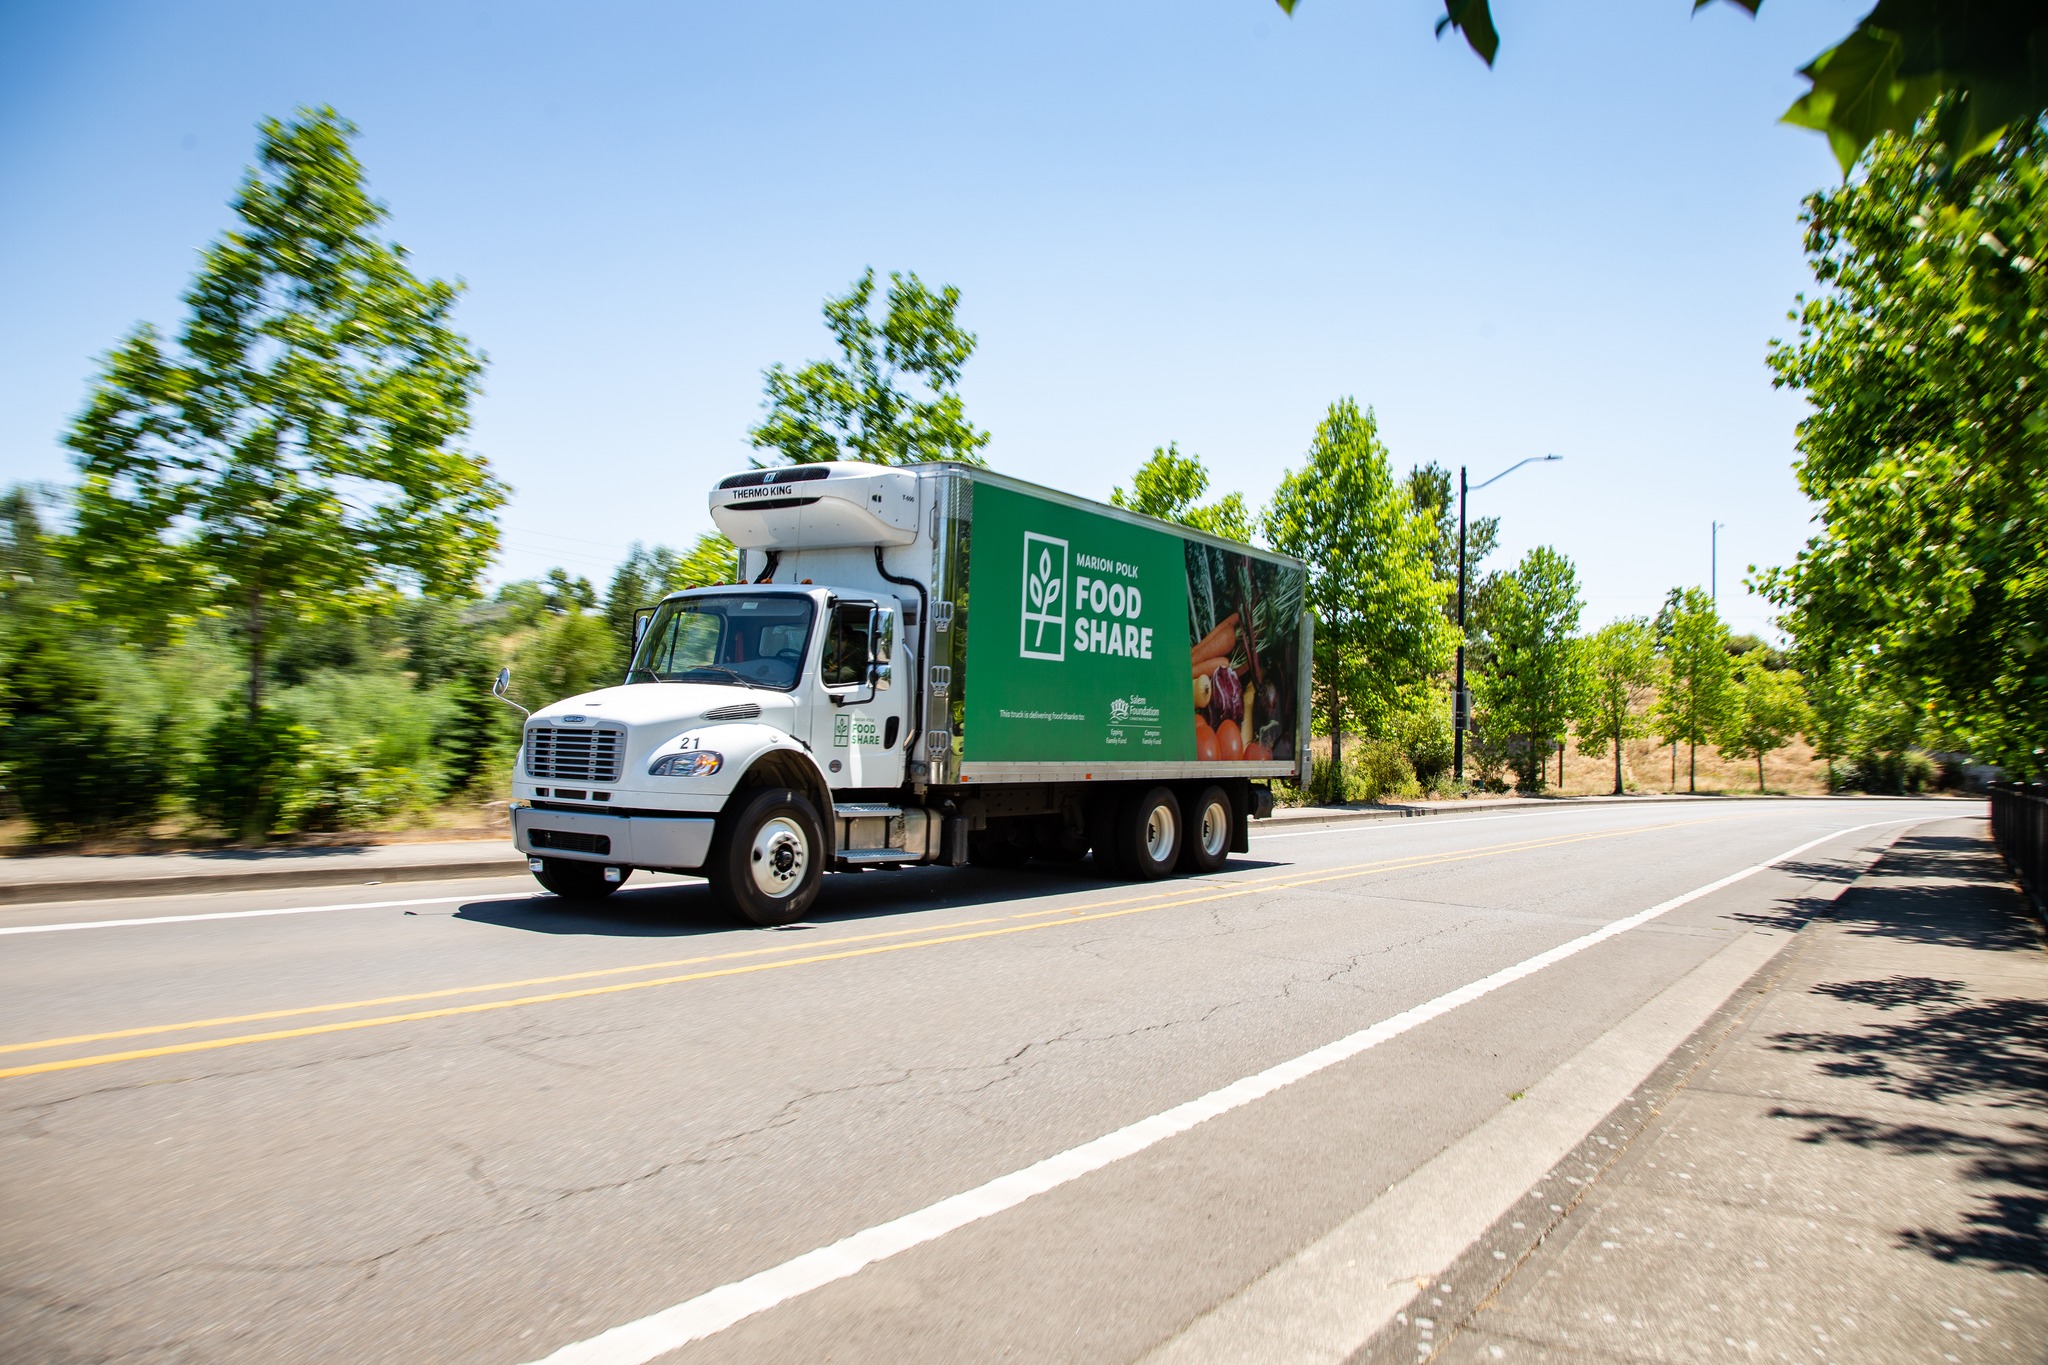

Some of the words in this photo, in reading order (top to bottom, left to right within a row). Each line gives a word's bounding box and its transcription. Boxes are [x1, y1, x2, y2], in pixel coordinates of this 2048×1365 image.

[732, 487, 769, 499] THERMO
[770, 485, 792, 497] KING
[1076, 553, 1113, 573] MARION
[1116, 561, 1138, 579] POLK
[1076, 576, 1142, 619] FOOD
[1073, 617, 1153, 660] SHARE
[1130, 694, 1146, 705] Salem
[999, 709, 1010, 718] This
[1130, 705, 1160, 716] Foundation
[852, 724, 876, 734] FOOD
[680, 737, 700, 750] 21
[851, 735, 880, 745] SHARE
